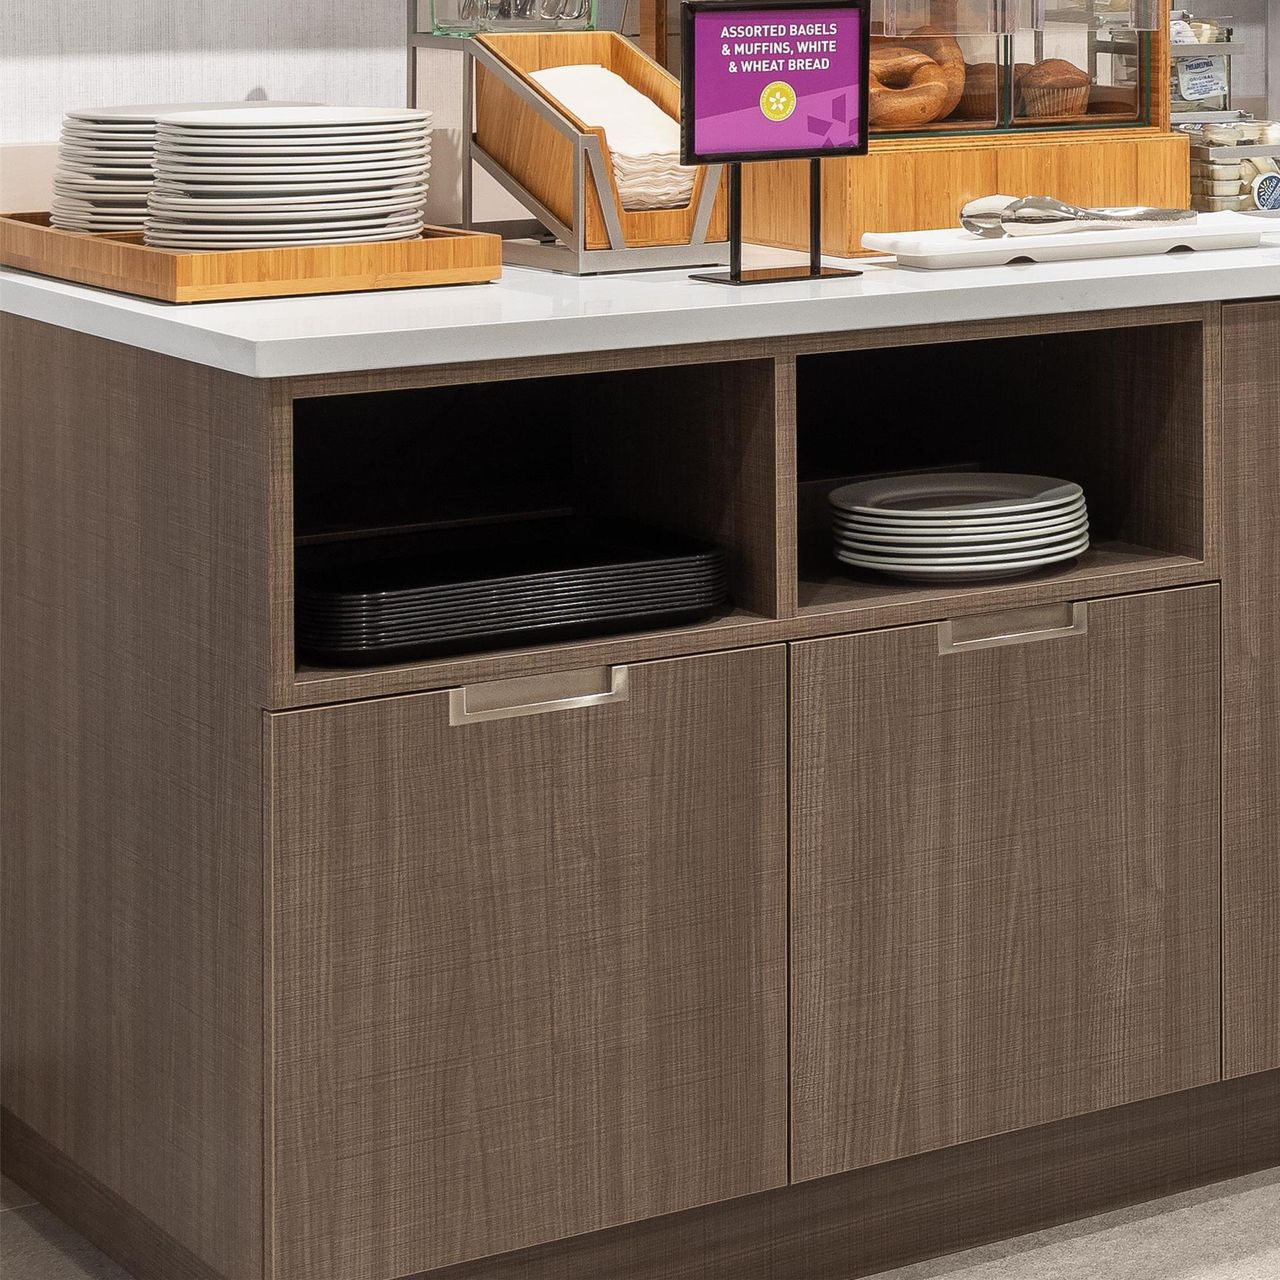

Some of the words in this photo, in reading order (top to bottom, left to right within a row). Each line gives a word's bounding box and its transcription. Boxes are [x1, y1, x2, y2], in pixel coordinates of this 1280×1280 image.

[720, 24, 787, 38] ASSORTED
[789, 23, 838, 36] BAGELS
[721, 43, 731, 56] &
[734, 41, 794, 56] MUFFINS,
[796, 40, 837, 54] WHITE
[728, 61, 738, 73] &
[740, 59, 786, 73] WHEAT
[787, 57, 830, 71] BREAD
